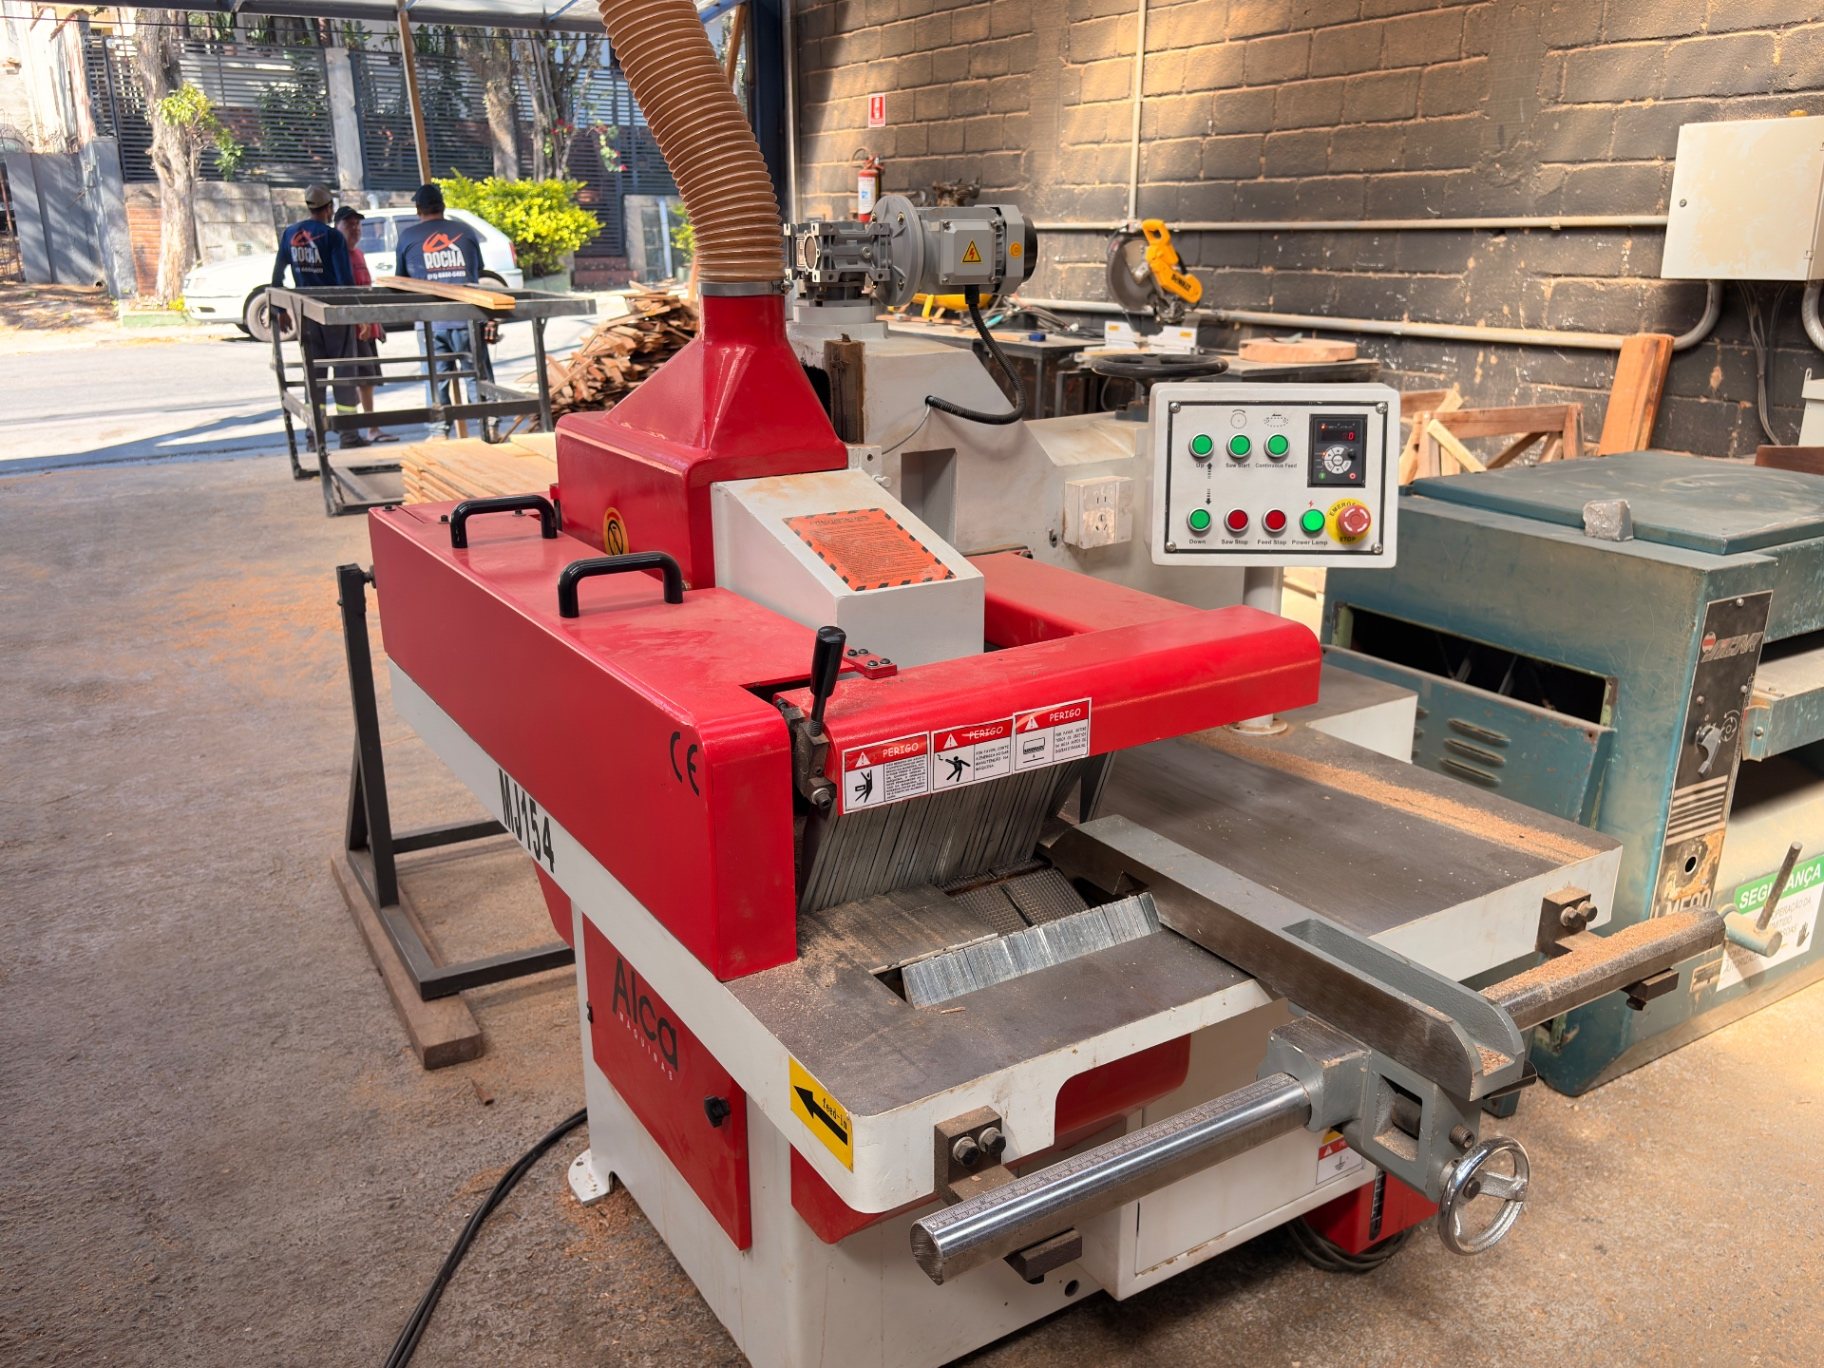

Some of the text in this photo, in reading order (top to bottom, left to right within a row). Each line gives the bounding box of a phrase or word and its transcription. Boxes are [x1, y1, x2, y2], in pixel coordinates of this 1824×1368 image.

[291, 246, 323, 264] ROCHA
[423, 250, 466, 269] ROCHA
[1312, 539, 1329, 547] Lamp
[1049, 708, 1081, 722] PERIGO
[969, 726, 1004, 740] PERIGO
[882, 742, 919, 758] PERIGO
[498, 768, 555, 874] MJ154
[1739, 863, 1821, 909] SEGANÇA
[612, 957, 679, 1073] Alca
